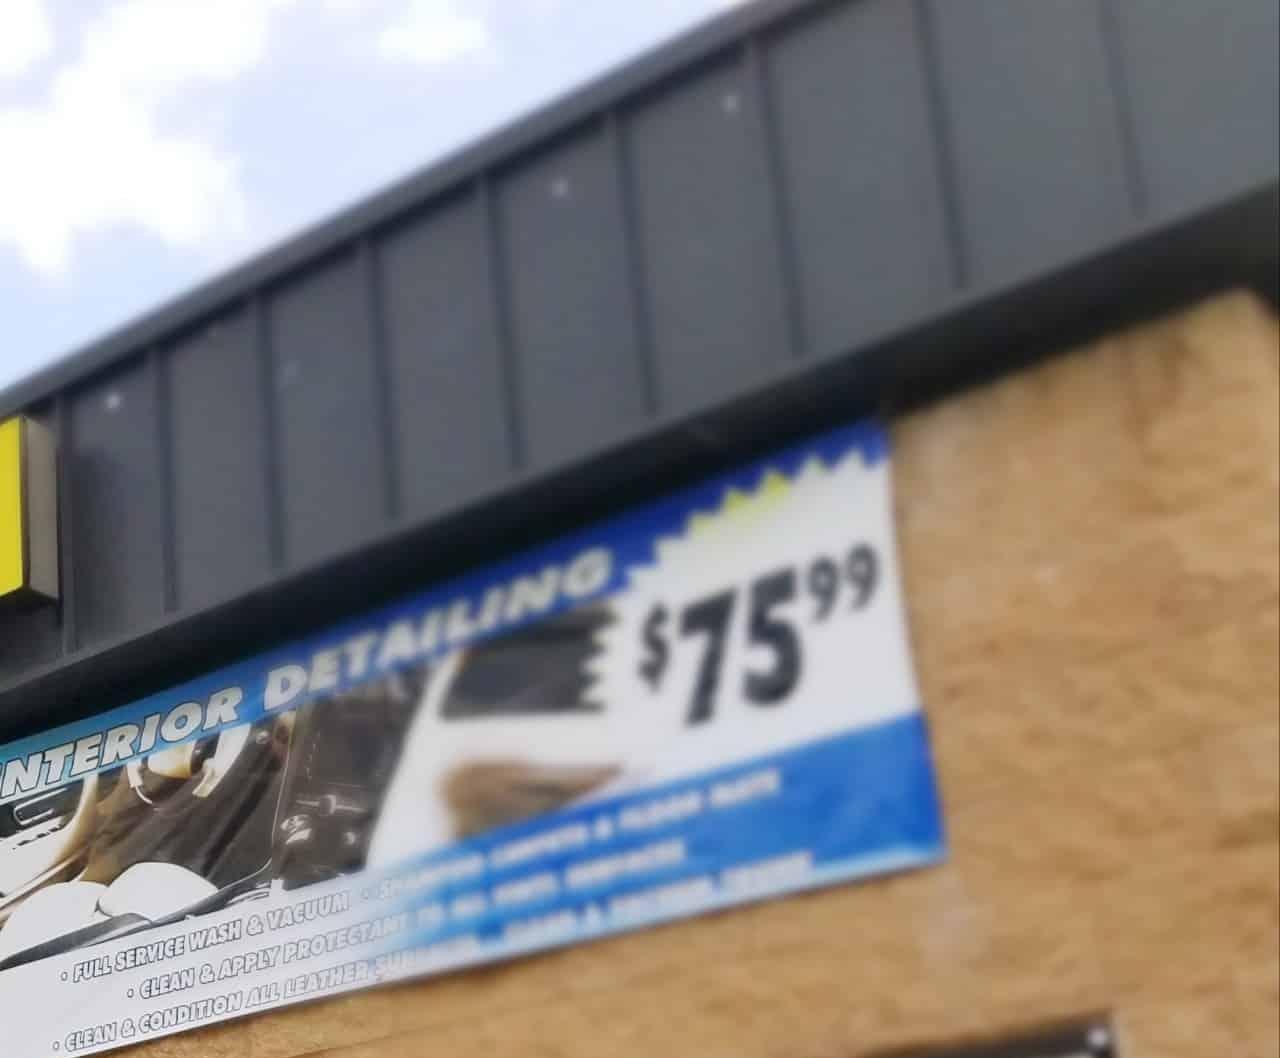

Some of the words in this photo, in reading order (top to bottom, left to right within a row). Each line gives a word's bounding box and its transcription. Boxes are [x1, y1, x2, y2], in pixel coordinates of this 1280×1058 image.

[263, 548, 614, 712] DETAILING
[72, 955, 112, 983] FULL
[114, 935, 186, 972] SERVICE
[188, 919, 242, 952] WASH
[246, 914, 264, 937] &
[266, 889, 351, 931] VACUUM
[139, 967, 195, 999] CLEAN
[199, 963, 216, 984] &
[218, 945, 280, 980] APPLY
[283, 911, 409, 965] PROTECTANT
[64, 1021, 117, 1052] CLEAN
[121, 1017, 136, 1039] &
[138, 990, 243, 1034] CONDITION
[244, 982, 281, 1009] ALL
[282, 959, 369, 1000] LEATHER
